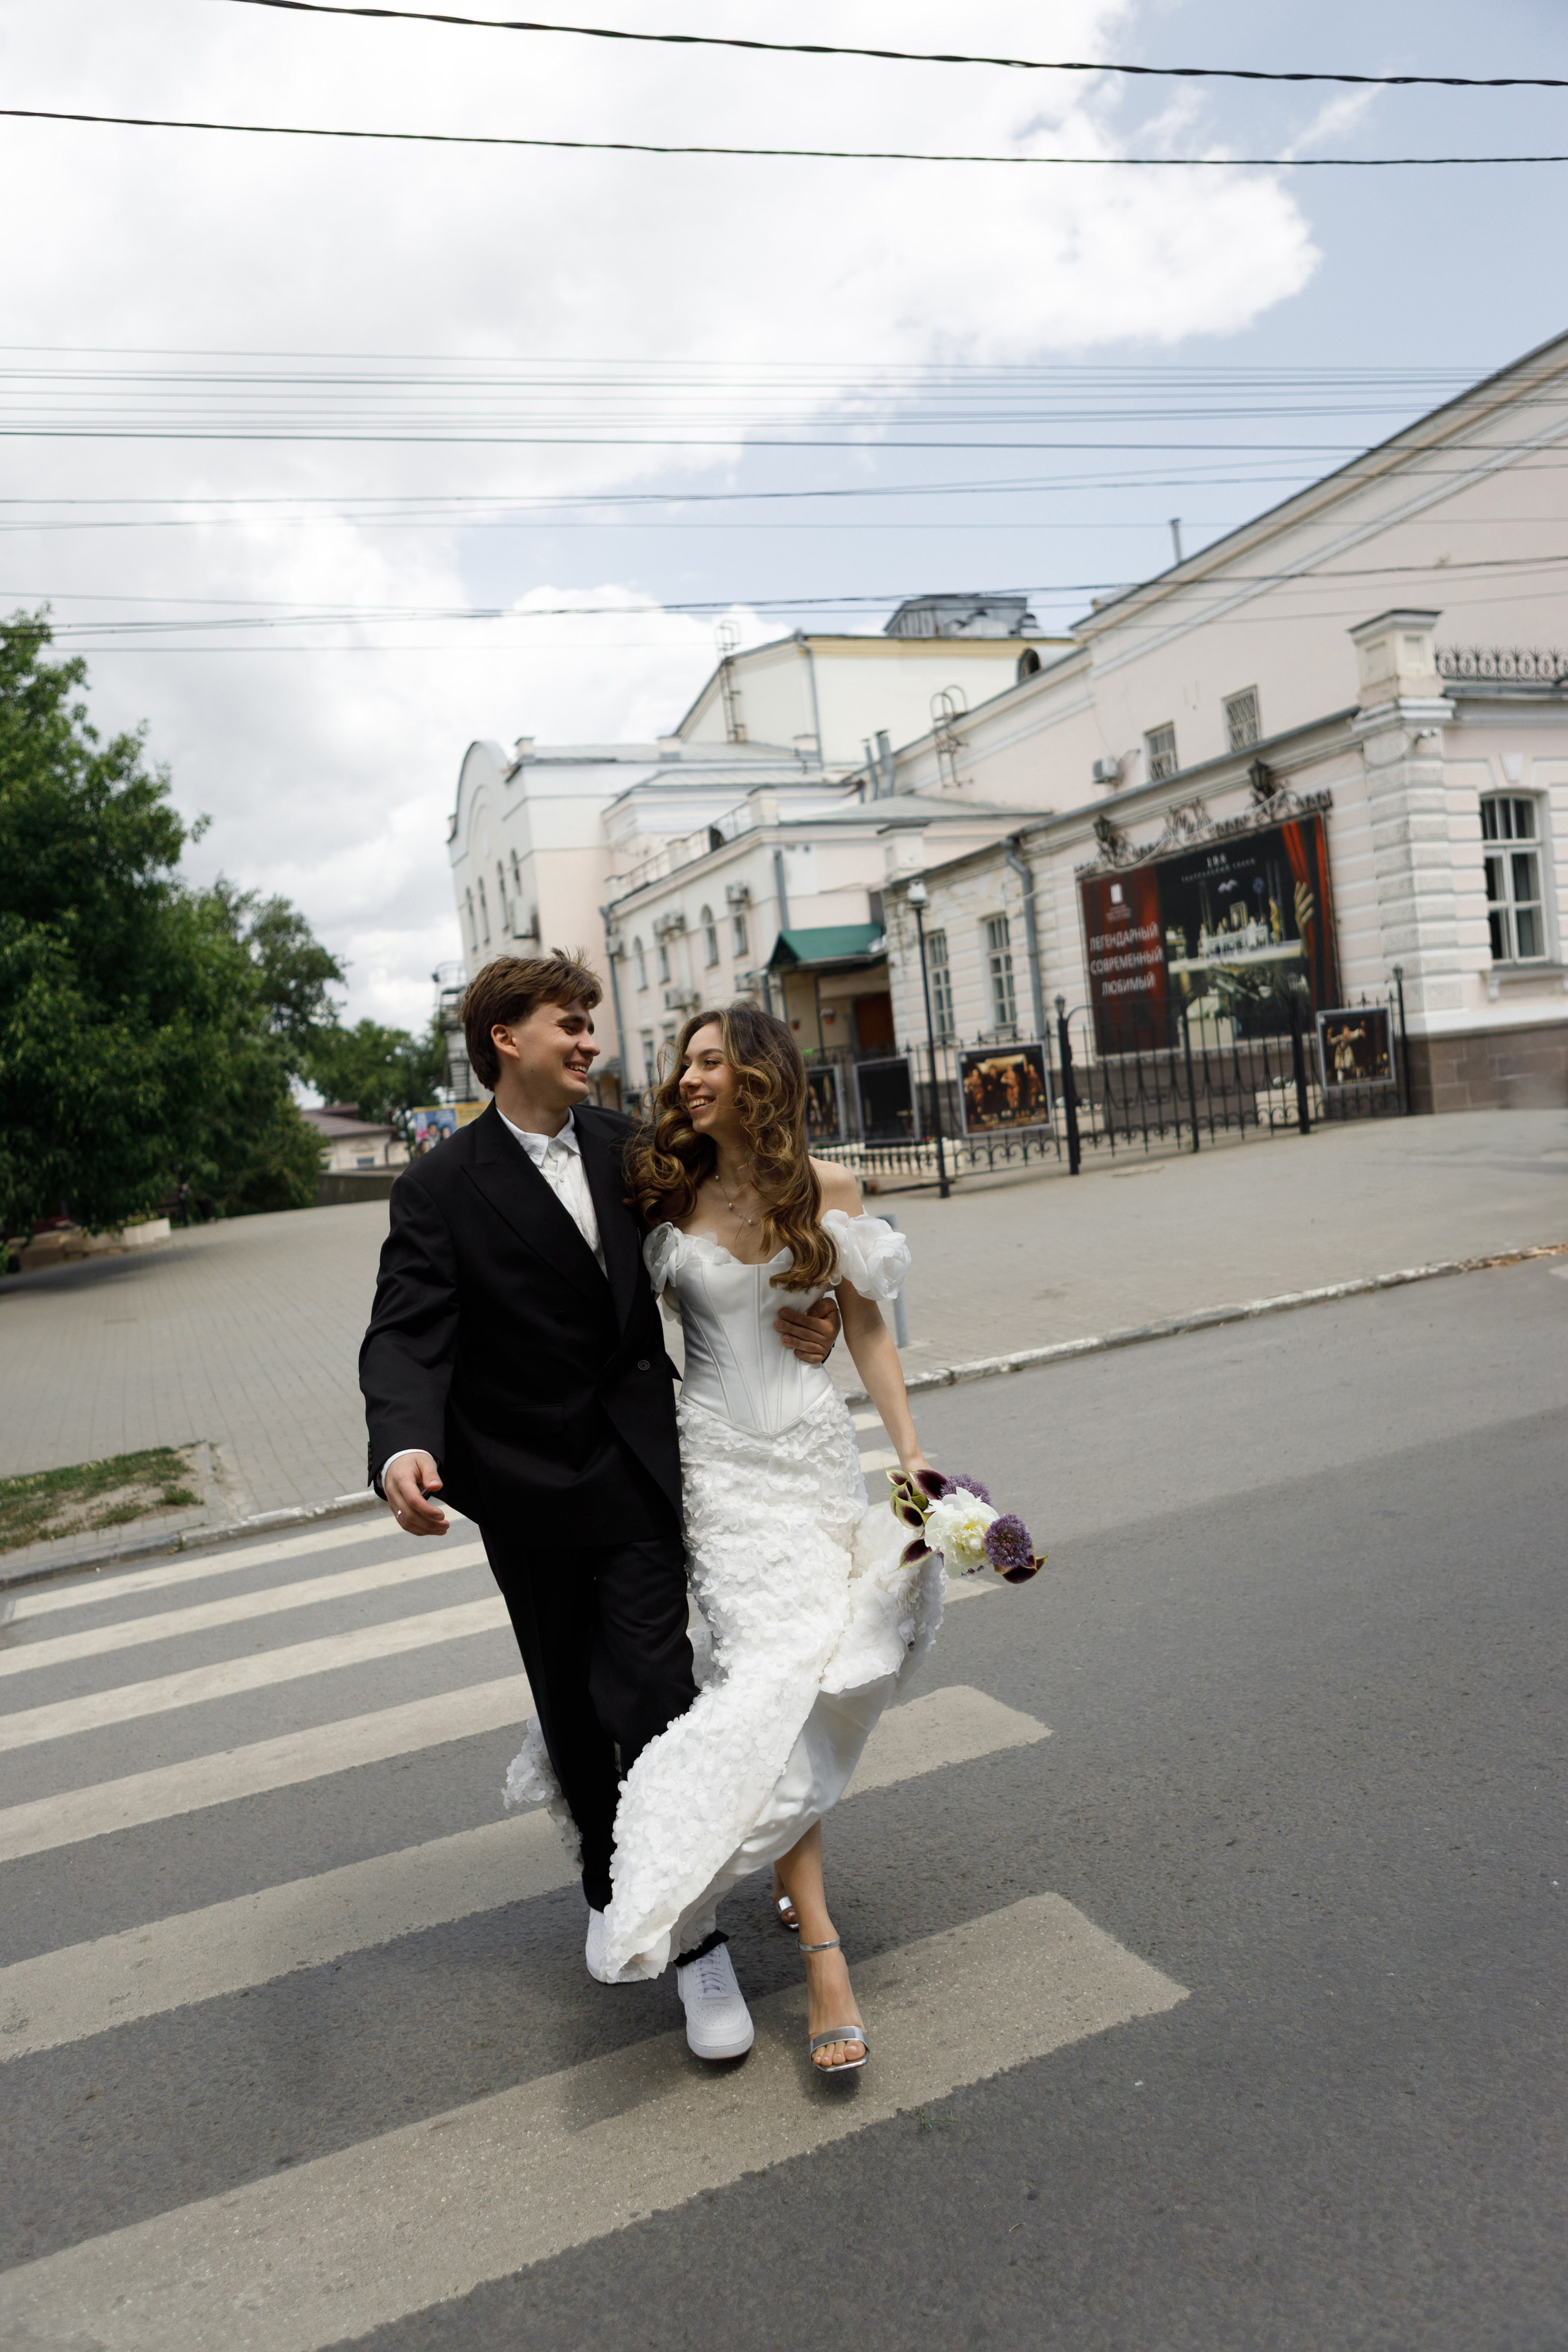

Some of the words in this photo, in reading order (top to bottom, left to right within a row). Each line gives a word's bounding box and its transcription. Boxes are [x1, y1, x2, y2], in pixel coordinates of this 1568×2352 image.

[1090, 921, 1159, 952] ЛЕГЕНДАРНЫЙ
[1090, 946, 1163, 976] СОВРЕМЕННЫЙ
[1102, 971, 1156, 997] ЛЮБИМЫЙ
